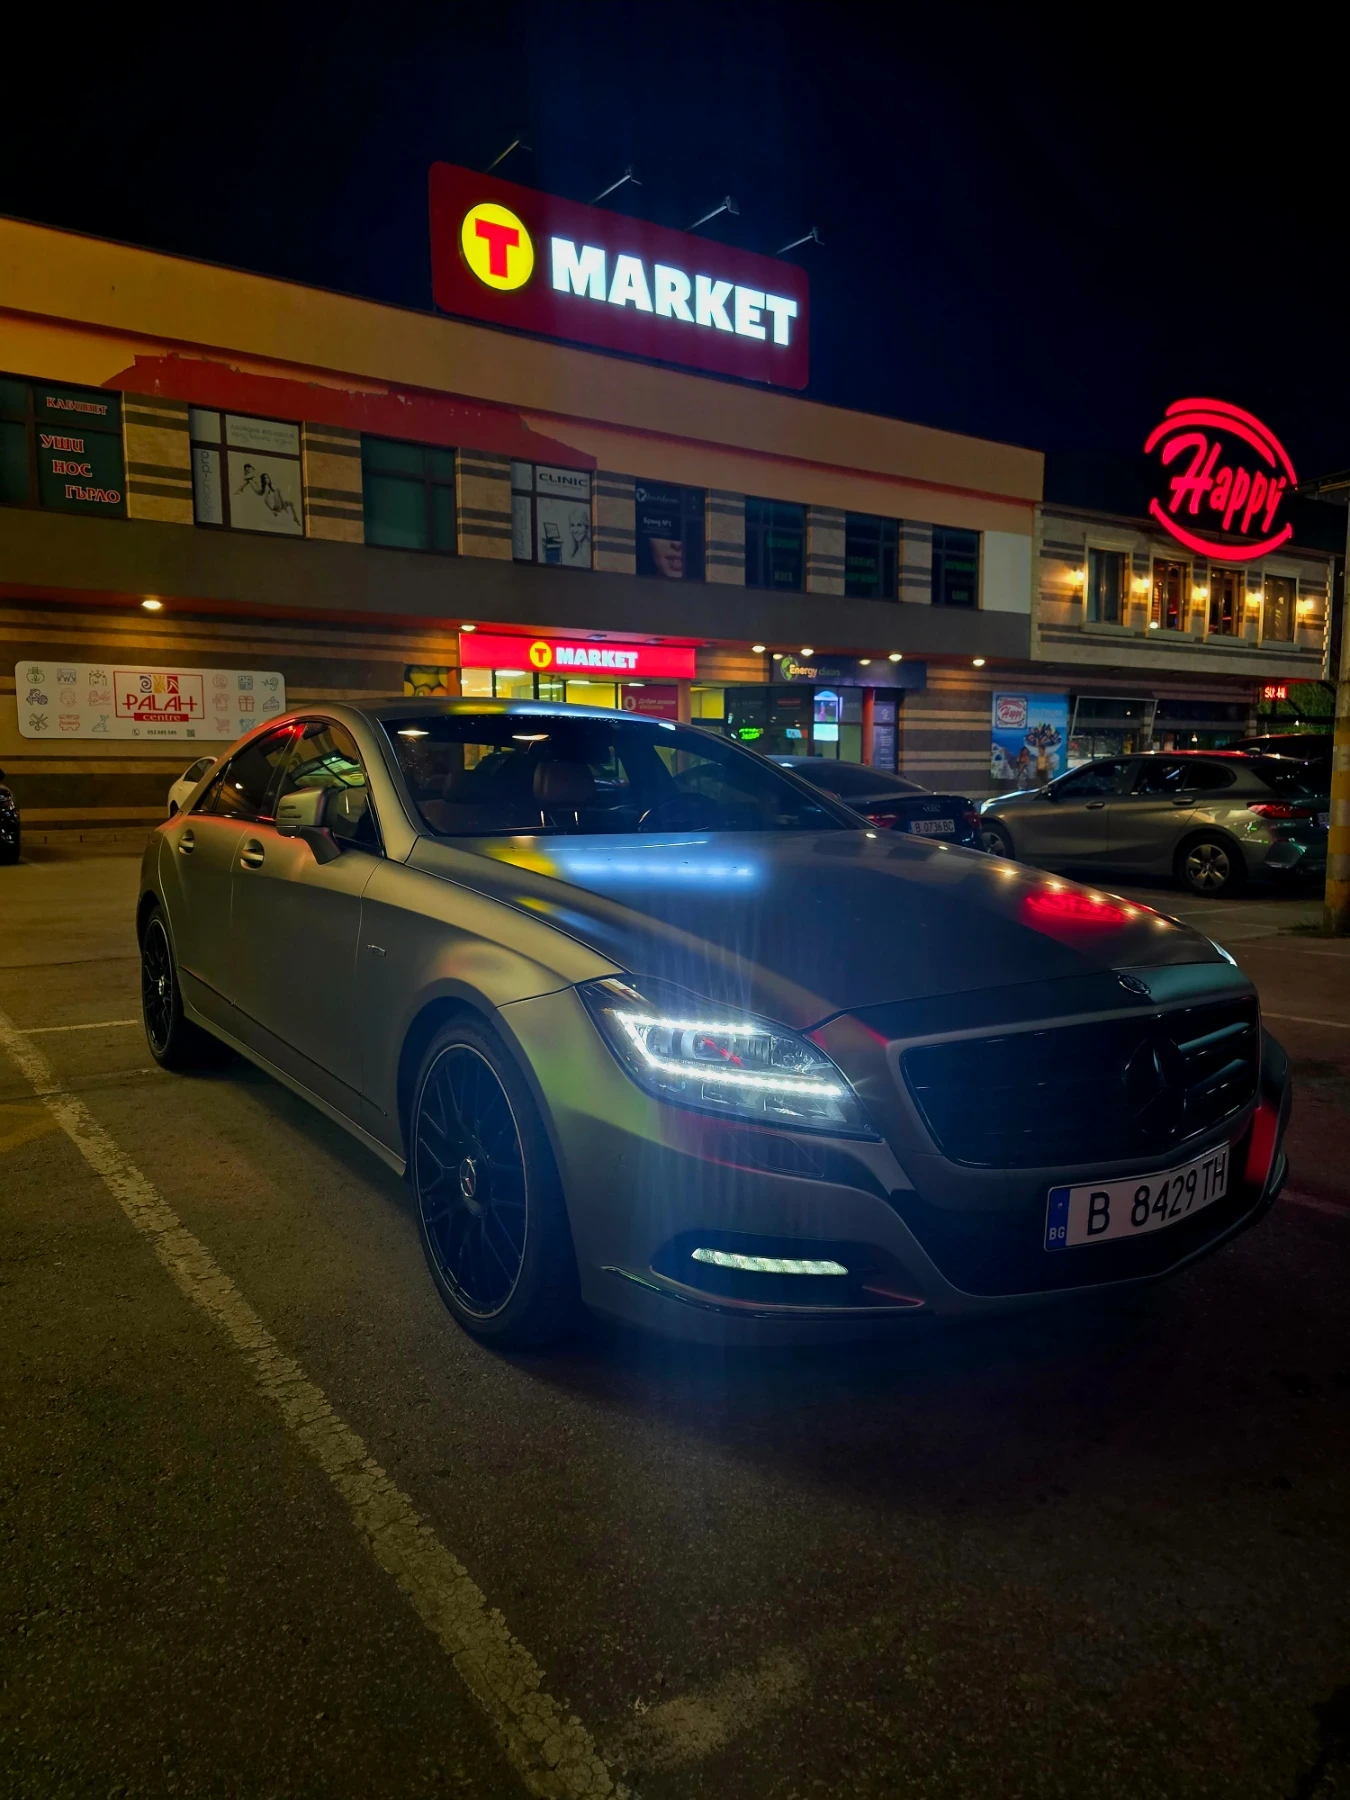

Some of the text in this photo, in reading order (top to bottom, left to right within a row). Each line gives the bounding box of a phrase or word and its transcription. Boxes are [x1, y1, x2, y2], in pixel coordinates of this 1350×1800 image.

[474, 217, 798, 346] T MARKET
[46, 396, 108, 415] КАБИНЕТ
[40, 433, 85, 453] УШИ
[52, 459, 92, 477] НОС
[538, 472, 588, 487] CLINIC
[1162, 432, 1287, 534] Happy
[65, 484, 120, 504] ГЪРЛО
[534, 646, 639, 669] T MARKET
[789, 663, 840, 679] Energy clean
[122, 693, 198, 712] PALAH
[143, 714, 181, 722] centre
[915, 822, 921, 833] B
[1087, 1151, 1226, 1236] B 8429 TH
[1048, 1227, 1066, 1241] BG
